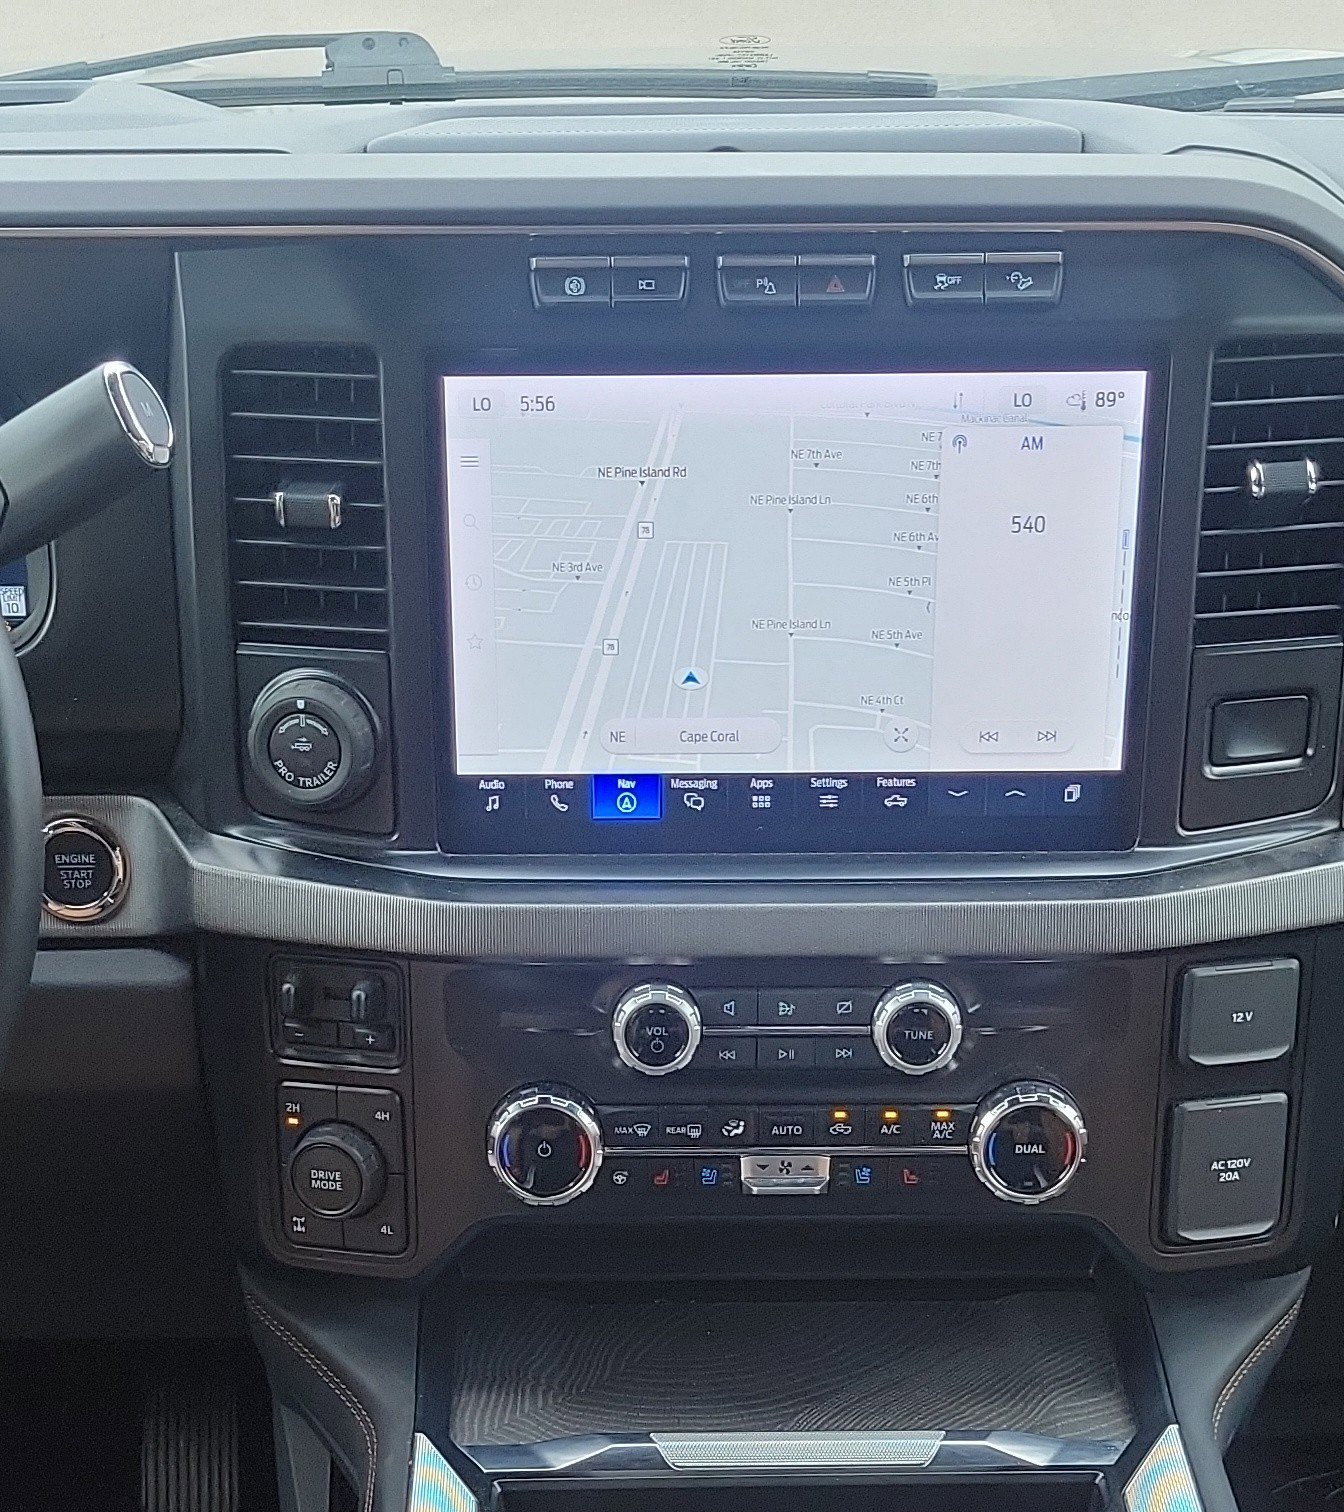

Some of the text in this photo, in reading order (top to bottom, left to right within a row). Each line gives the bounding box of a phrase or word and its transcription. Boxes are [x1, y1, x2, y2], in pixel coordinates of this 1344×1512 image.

[473, 396, 491, 412] LO
[520, 395, 556, 412] 5:56
[1013, 392, 1032, 408] LO
[1094, 390, 1126, 408] 89°
[1020, 435, 1044, 451] AM
[791, 448, 843, 460] NE 7th Ave
[910, 460, 924, 471] NE
[597, 466, 687, 478] NE Pine Island Rd
[750, 494, 831, 505] NE Pine Island Ln
[906, 493, 939, 504] NE 6th
[1011, 515, 1046, 534] 540
[893, 531, 907, 542] NE
[908, 531, 926, 542] 6th
[552, 562, 603, 573] NE 3rd Ave
[888, 576, 902, 587] NE
[903, 576, 921, 587] 5th
[6, 602, 19, 614] 10
[751, 619, 831, 630] NE Pine Island Ln
[871, 630, 923, 640] NE 5th Ave
[860, 695, 875, 706] NE
[609, 730, 626, 743] NE
[679, 730, 739, 745] Cape Coral
[273, 758, 339, 790] PRO TRAILER
[478, 778, 505, 790] Audio
[544, 778, 574, 790] Phone
[617, 778, 636, 789] Nav
[670, 778, 718, 791] Messaging
[749, 778, 774, 791] Apps
[810, 776, 848, 788] Settings
[876, 776, 916, 788] Features
[54, 854, 96, 865] ENGINE
[60, 869, 94, 880] START
[63, 878, 92, 889] STOP
[645, 1026, 669, 1037] VOL
[904, 1029, 934, 1041] TUNE
[285, 1102, 300, 1114] 2H
[374, 1111, 390, 1122] 4H
[614, 1125, 634, 1135] MAX
[665, 1125, 686, 1135] REAR
[771, 1125, 803, 1136] AUTO
[880, 1125, 901, 1135] A/C
[931, 1121, 955, 1131] MAX
[933, 1130, 953, 1139] A/C
[1014, 1143, 1046, 1154] DUAL
[1211, 1157, 1252, 1171] AC 120V
[310, 1169, 343, 1182] DRIVE
[1218, 1171, 1240, 1182] 20A
[311, 1180, 343, 1191] MODE
[380, 1224, 394, 1236] 4L
